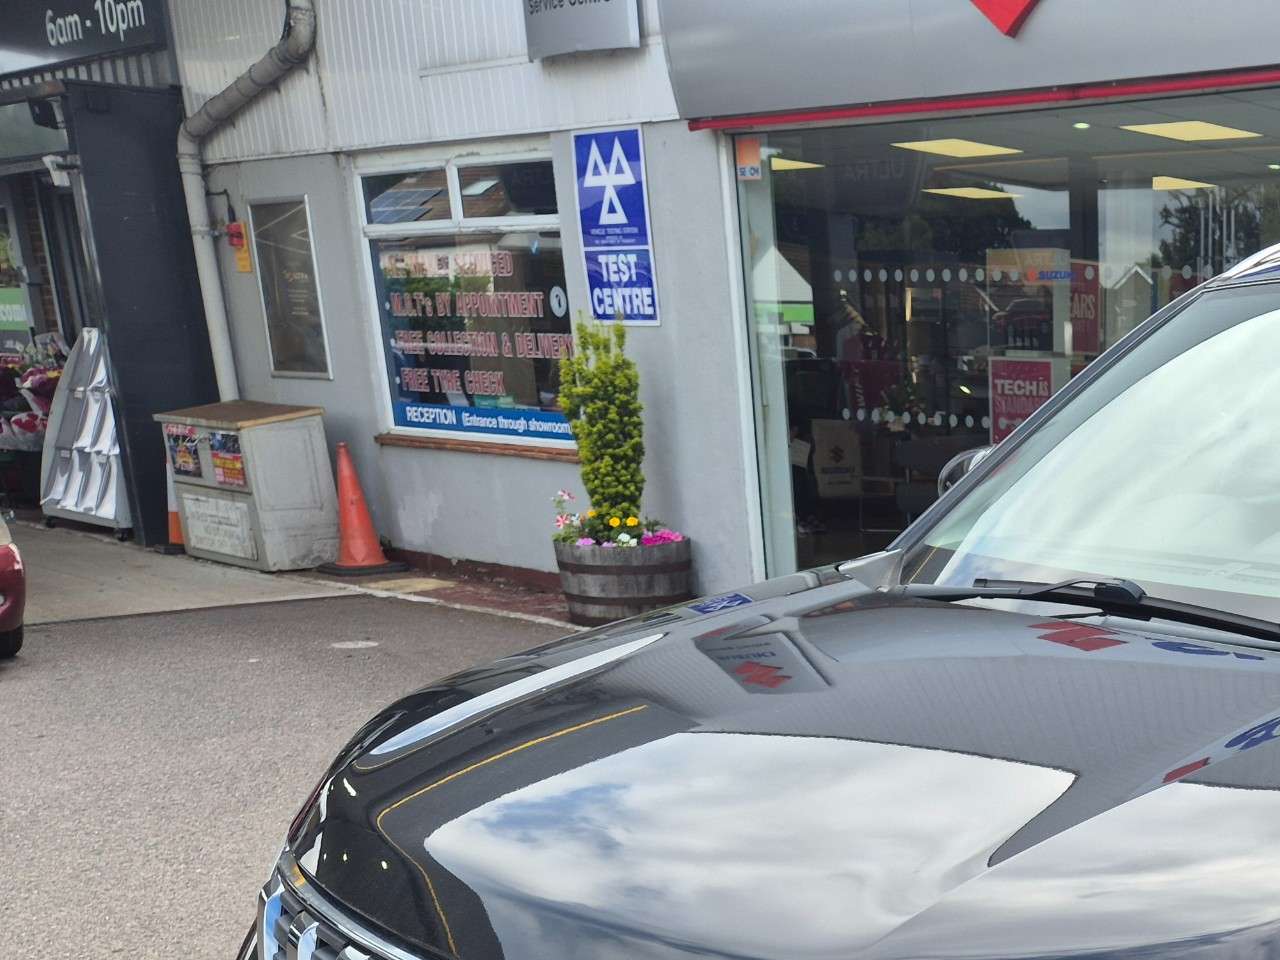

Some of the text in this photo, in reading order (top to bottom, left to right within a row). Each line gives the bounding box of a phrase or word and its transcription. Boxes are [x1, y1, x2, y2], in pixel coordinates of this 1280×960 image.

[46, 9, 83, 46] 6am
[94, 0, 146, 42] 10pm
[597, 253, 638, 282] TEST
[434, 291, 452, 317] BY
[455, 291, 545, 318] APPOINTMENT
[592, 287, 655, 315] CENTRE
[1070, 294, 1096, 320] ARS
[395, 330, 425, 356] FREE
[426, 330, 499, 358] COLLECTION
[501, 332, 514, 358] &
[400, 366, 507, 397] FREE TYRE CHECK
[994, 378, 1038, 397] TECH
[405, 406, 458, 425] RECEPTION
[461, 411, 498, 428] (Entrance
[497, 415, 528, 432] through
